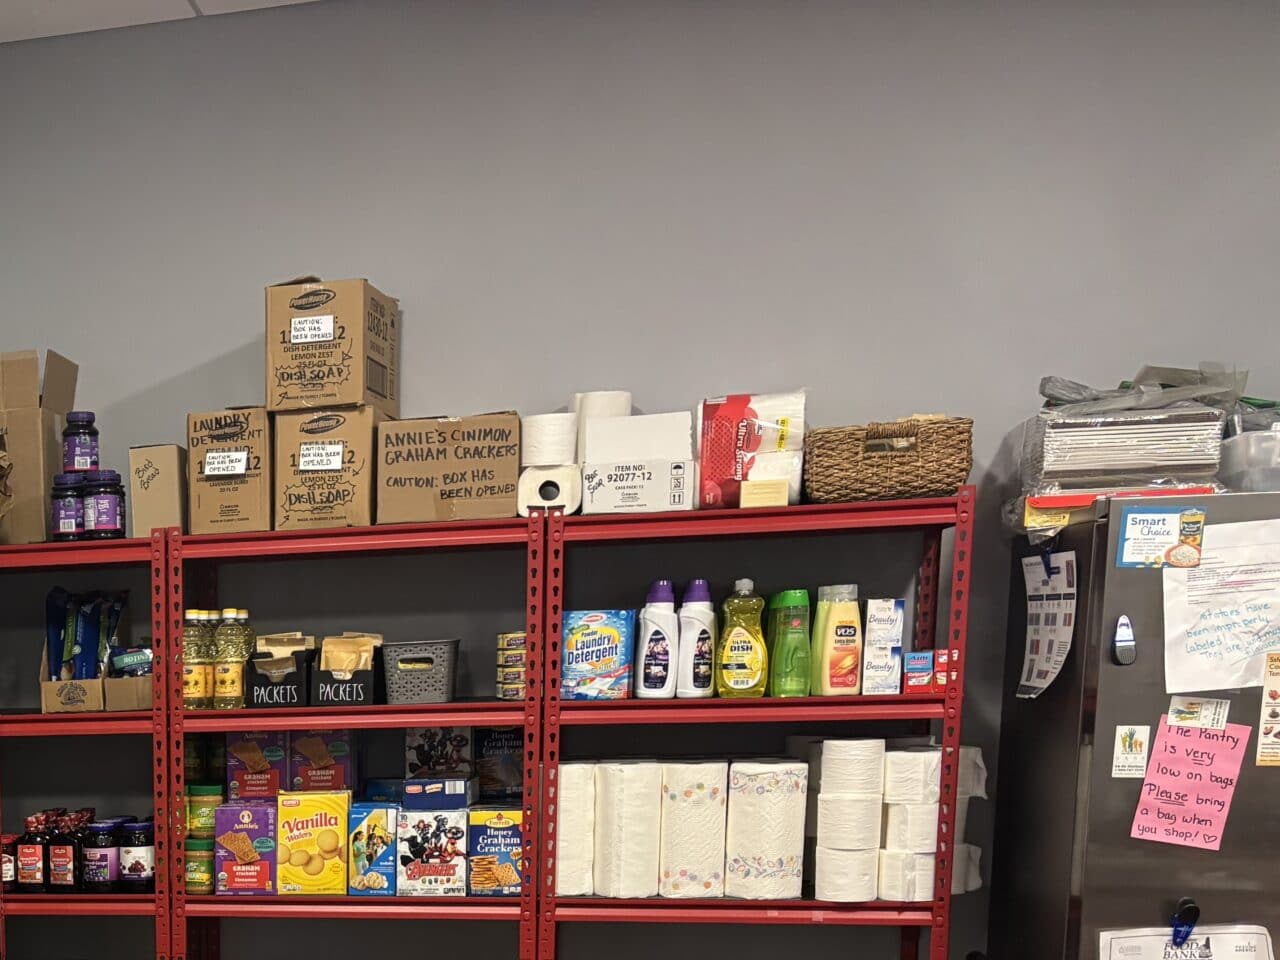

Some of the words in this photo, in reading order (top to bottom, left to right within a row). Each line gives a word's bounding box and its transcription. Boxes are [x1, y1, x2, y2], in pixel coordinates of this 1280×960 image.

[291, 352, 316, 360] LEMON
[301, 343, 342, 352] DETERGENT
[280, 371, 306, 381] DISH
[310, 368, 344, 381] SOAP
[194, 412, 251, 432] LAUNDRY
[384, 428, 447, 448] ANNIE'S
[450, 428, 512, 442] CINIMON
[736, 418, 748, 448] Ultra
[302, 459, 332, 467] OPENED
[384, 447, 447, 466] GRAHAM
[454, 443, 518, 460] CRACKERS
[734, 449, 743, 480] Strong
[386, 476, 438, 488] CAUTION:
[442, 470, 468, 486] BOX
[472, 468, 495, 482] HAS
[607, 472, 652, 483] 92077-12
[288, 491, 315, 506] DISH
[320, 489, 350, 504] SOAP
[440, 486, 472, 500] BEEN
[476, 483, 516, 498] OPENED
[1130, 517, 1166, 526] Smart
[1140, 525, 1172, 536] Choice
[575, 634, 612, 651] Laundry
[580, 630, 598, 638] Powder
[567, 644, 620, 666] Detergent
[254, 684, 298, 704] PACKETS
[319, 684, 364, 701] PACKETS
[1166, 724, 1192, 738] The
[1198, 728, 1240, 750] Pantry
[1164, 741, 1177, 754] is
[1185, 748, 1216, 766] very
[1156, 762, 1181, 778] low
[1186, 772, 1202, 782] on
[1144, 782, 1189, 802] Please
[1196, 793, 1225, 812] bring
[282, 812, 338, 834] Vanilla
[1140, 806, 1149, 816] a
[1156, 808, 1177, 826] bag
[1182, 813, 1212, 826] when
[286, 831, 313, 843] Wafers
[486, 828, 513, 837] Honey
[1138, 824, 1157, 836] you
[1164, 826, 1200, 842] shop!
[1162, 950, 1198, 960] BANK
